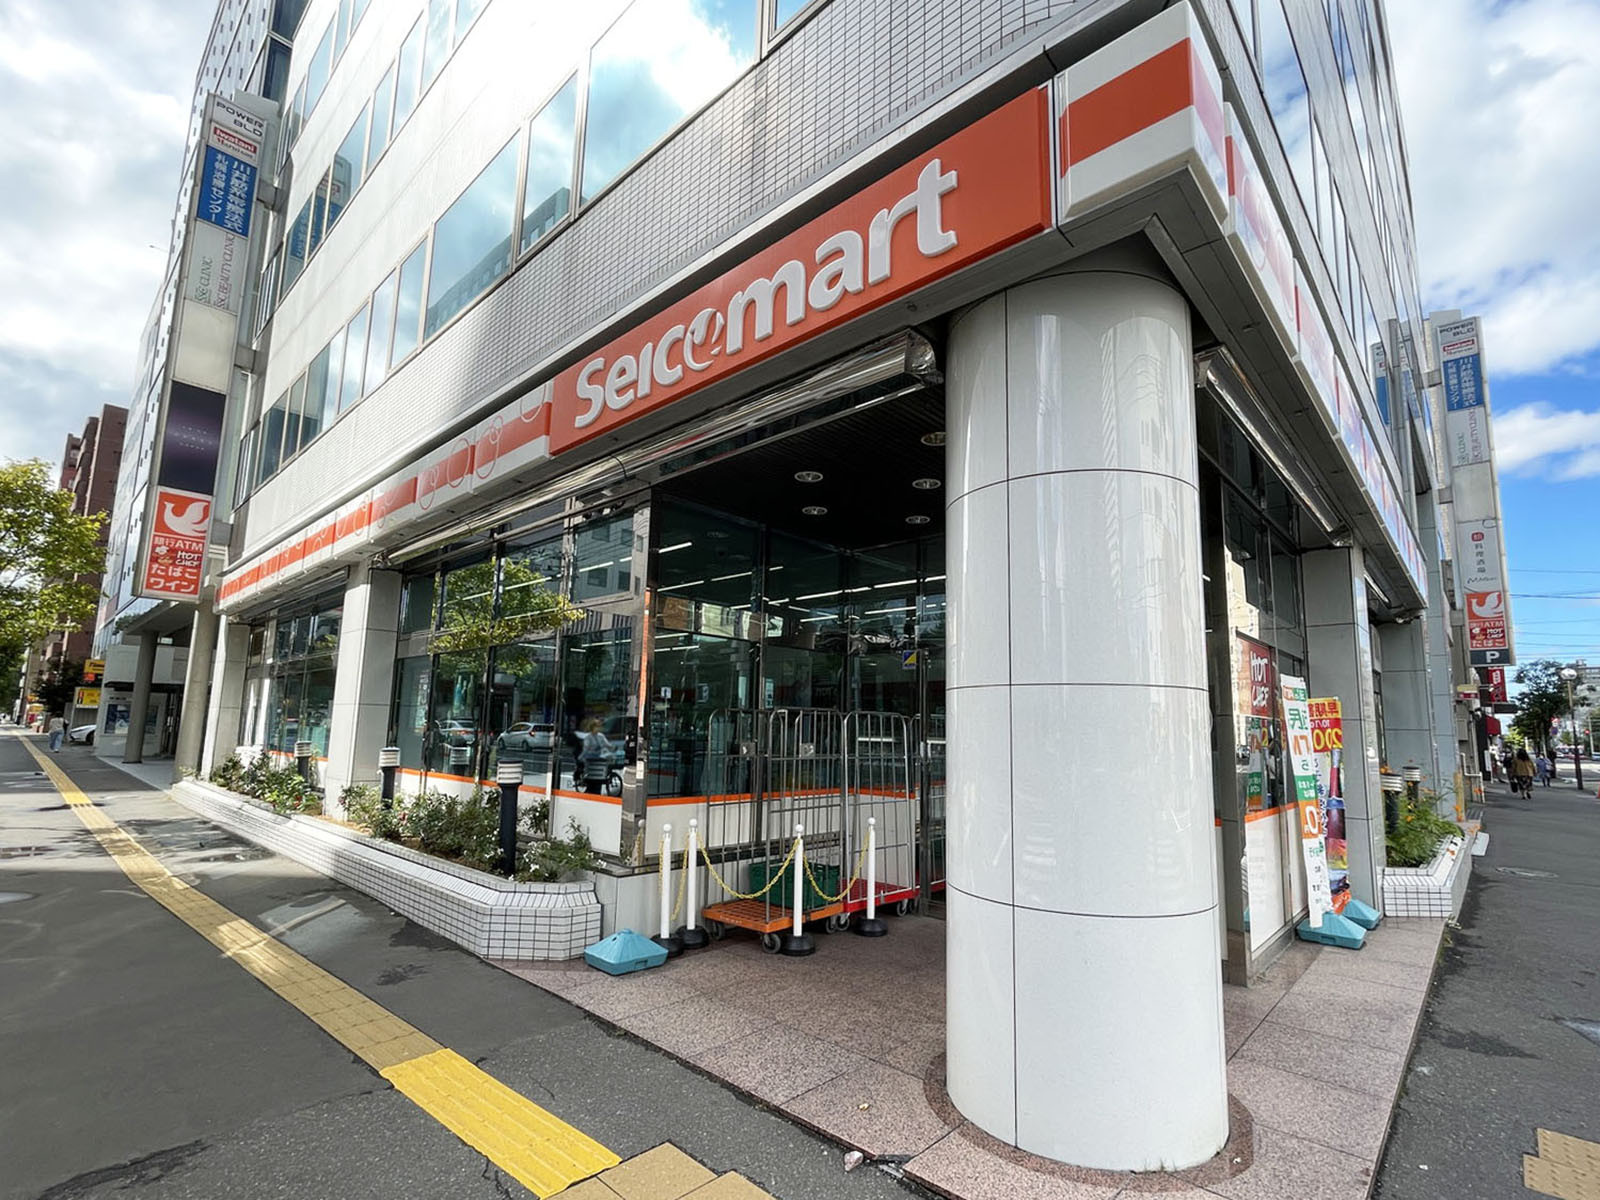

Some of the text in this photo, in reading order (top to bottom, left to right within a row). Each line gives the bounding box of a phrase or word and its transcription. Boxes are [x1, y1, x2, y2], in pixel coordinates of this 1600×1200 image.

[216, 101, 264, 128] POWER
[233, 119, 263, 137] BLD
[215, 129, 255, 152] Iwatani
[176, 550, 202, 560] HOT
[151, 563, 198, 579] たばこ
[149, 577, 195, 592] ワイン
[1485, 650, 1500, 664] P
[1250, 650, 1269, 683] HOT
